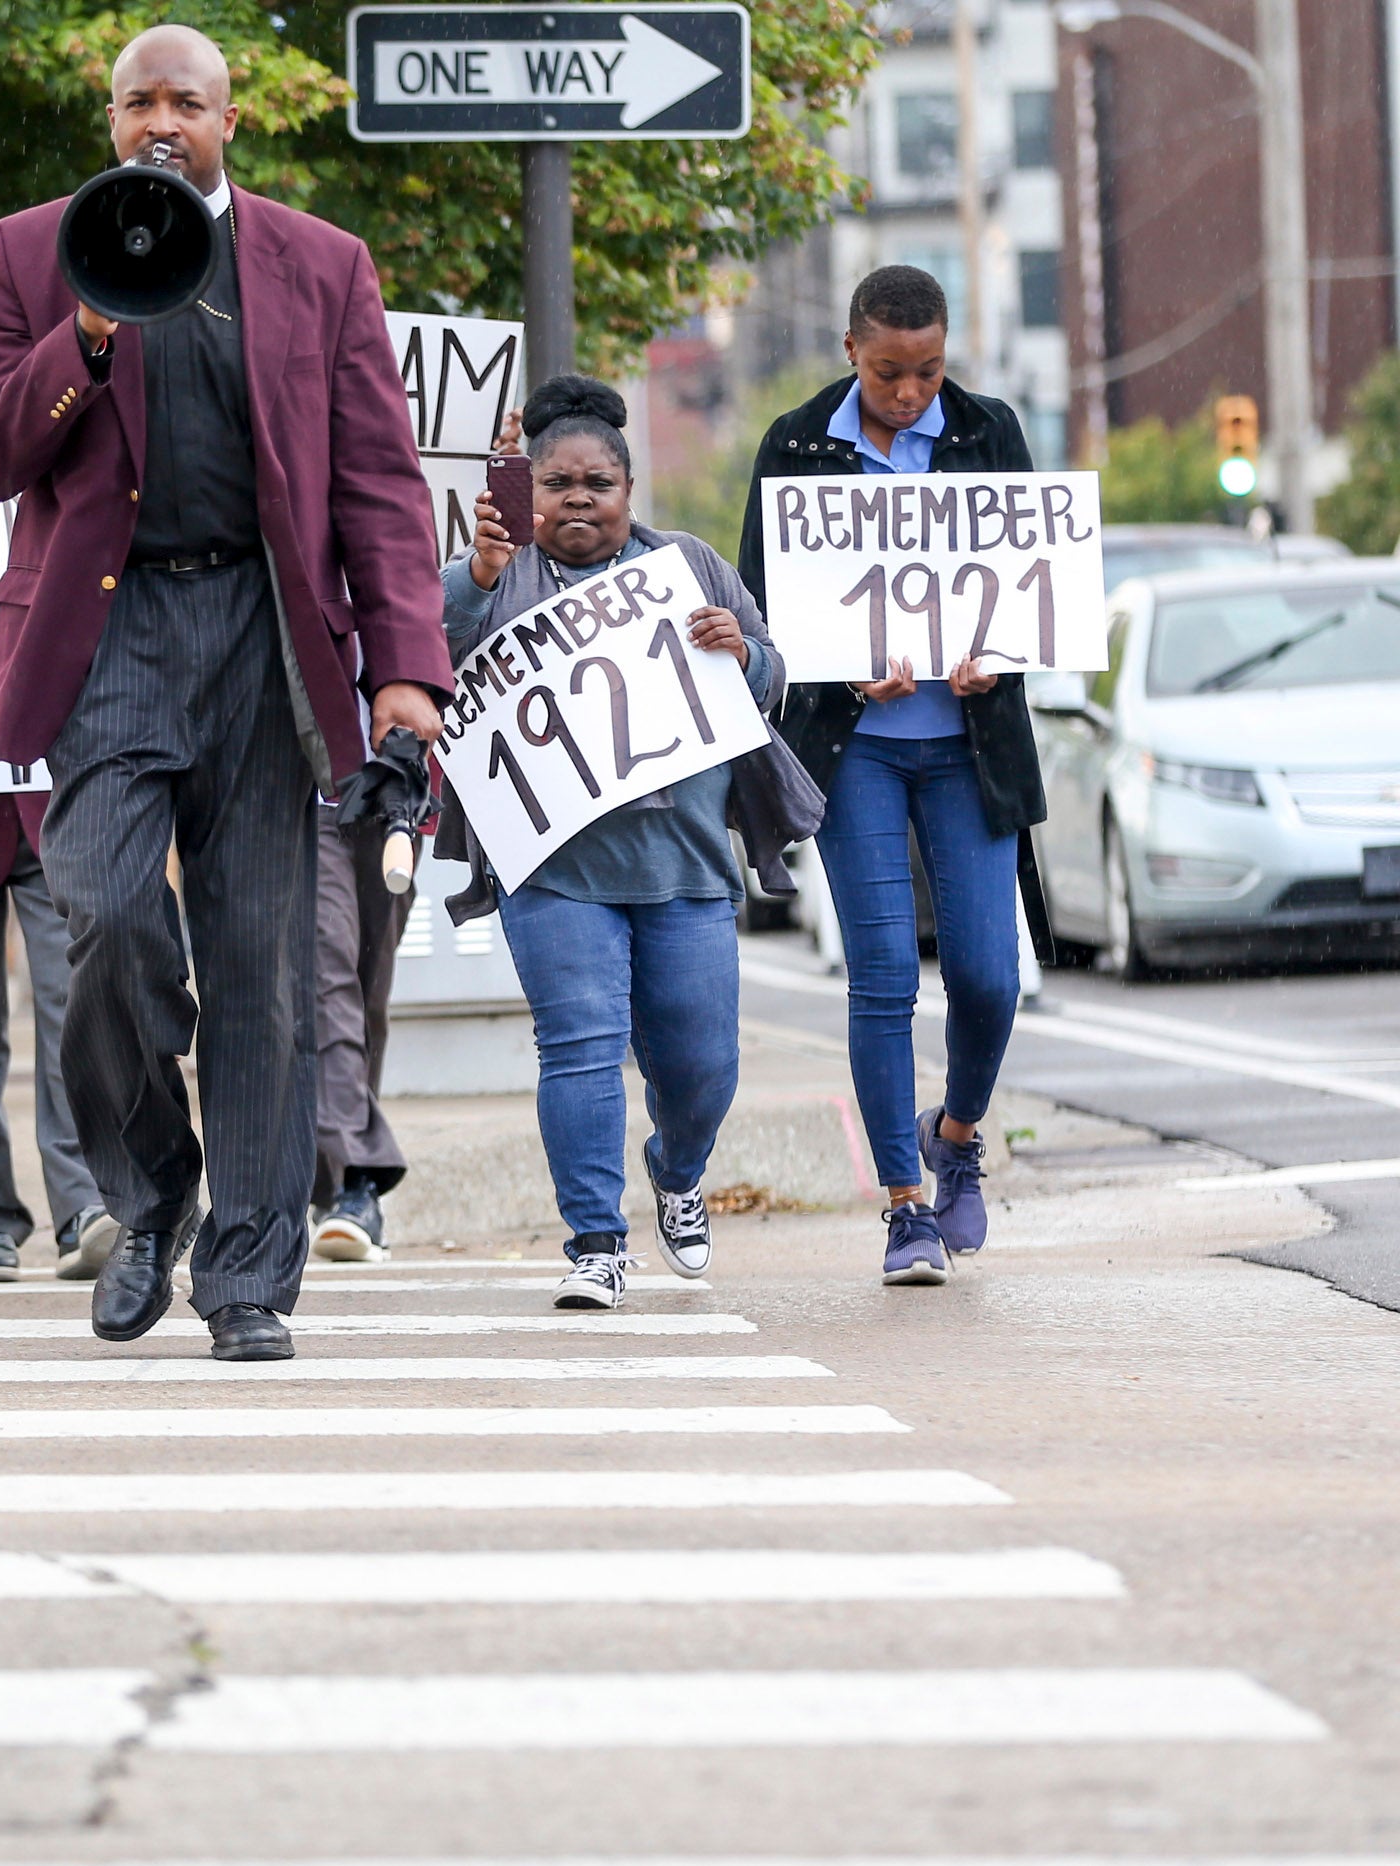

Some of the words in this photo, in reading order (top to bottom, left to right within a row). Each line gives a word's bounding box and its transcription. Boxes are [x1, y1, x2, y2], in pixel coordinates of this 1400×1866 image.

[398, 51, 489, 95] ONE
[525, 51, 623, 95] WAY
[401, 326, 517, 451] AM
[777, 484, 1093, 553] REMEMBER
[840, 558, 1055, 680] 1921
[488, 618, 716, 836] 1921
